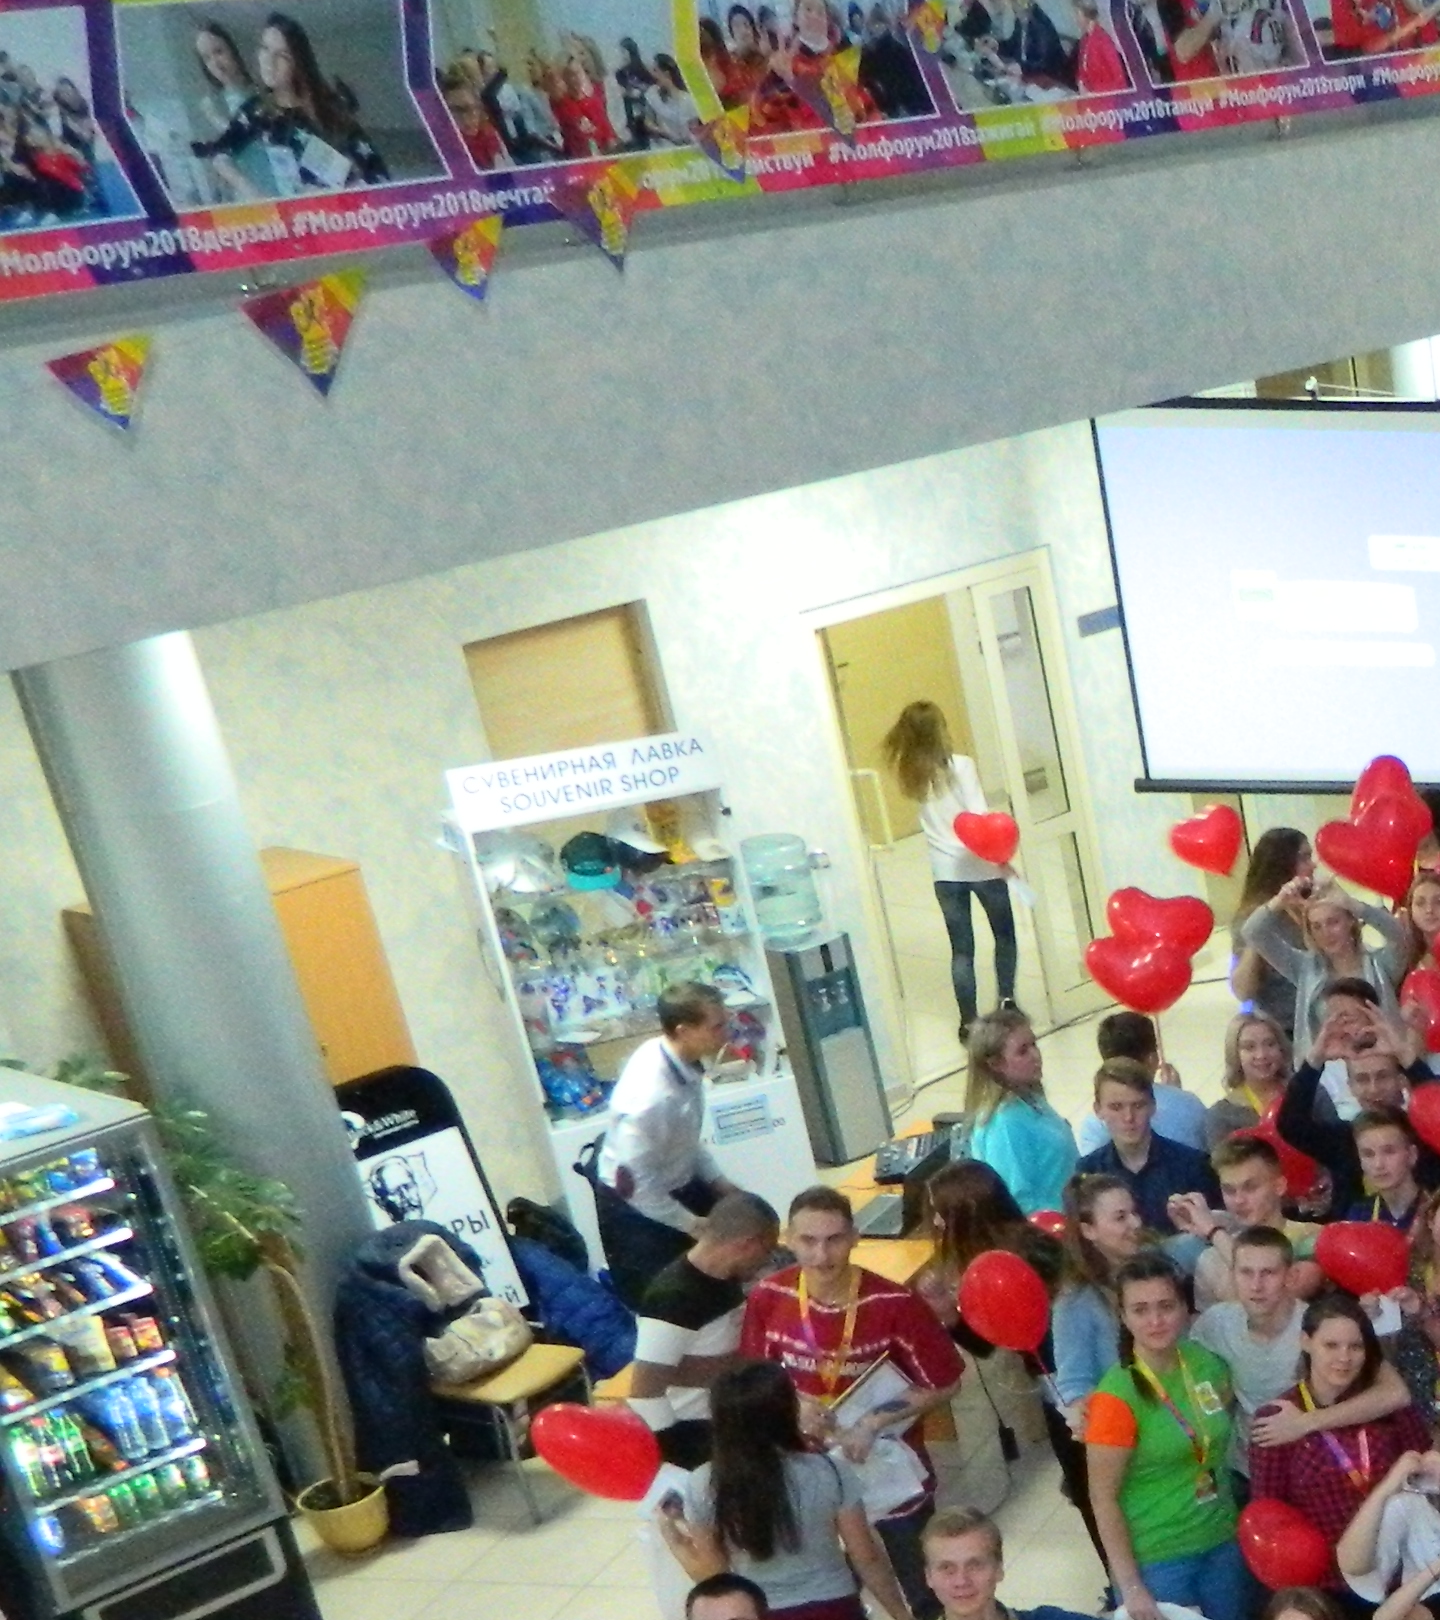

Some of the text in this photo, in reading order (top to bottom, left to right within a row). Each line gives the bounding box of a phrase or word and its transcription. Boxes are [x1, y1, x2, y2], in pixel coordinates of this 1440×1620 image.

[463, 738, 704, 794] СУВЕНИРНАЯ ЛАВКА
[500, 766, 680, 814] SOUVENIR SHOP
